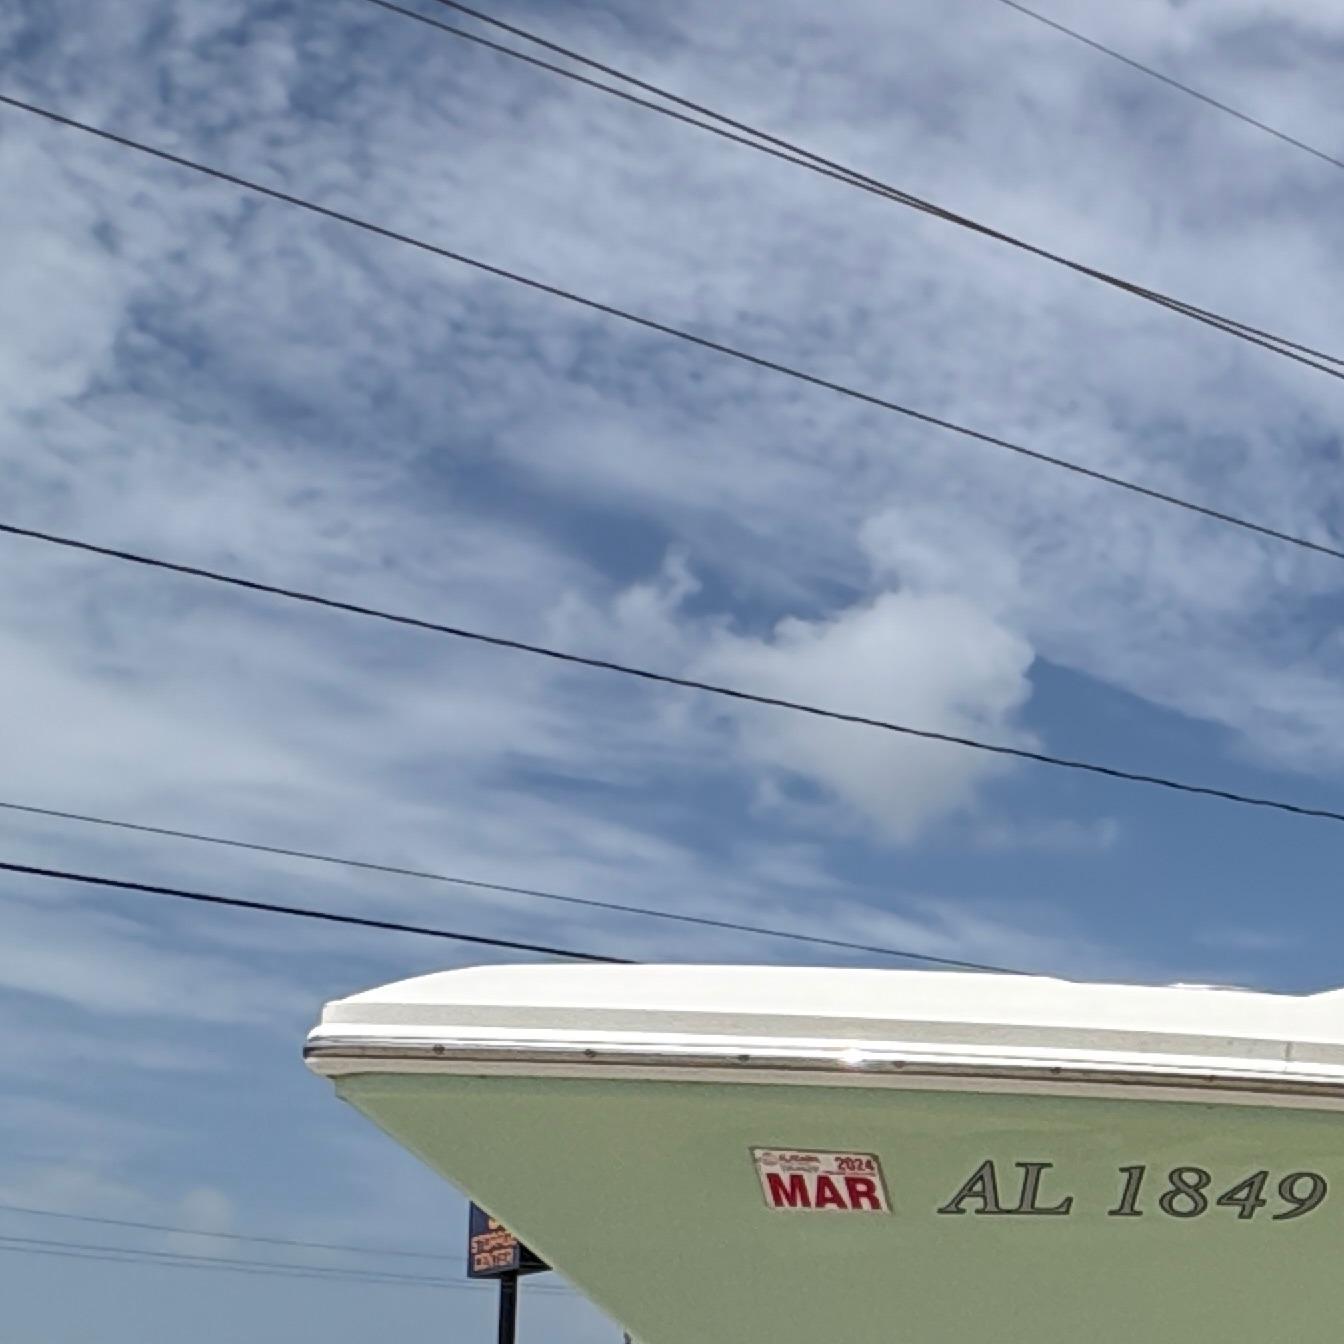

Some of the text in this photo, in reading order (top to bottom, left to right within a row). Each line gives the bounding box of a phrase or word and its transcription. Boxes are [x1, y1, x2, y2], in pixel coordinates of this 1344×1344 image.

[766, 1172, 882, 1210] MAR
[936, 1159, 1074, 1215] AL
[1107, 1164, 1328, 1220] 1849
